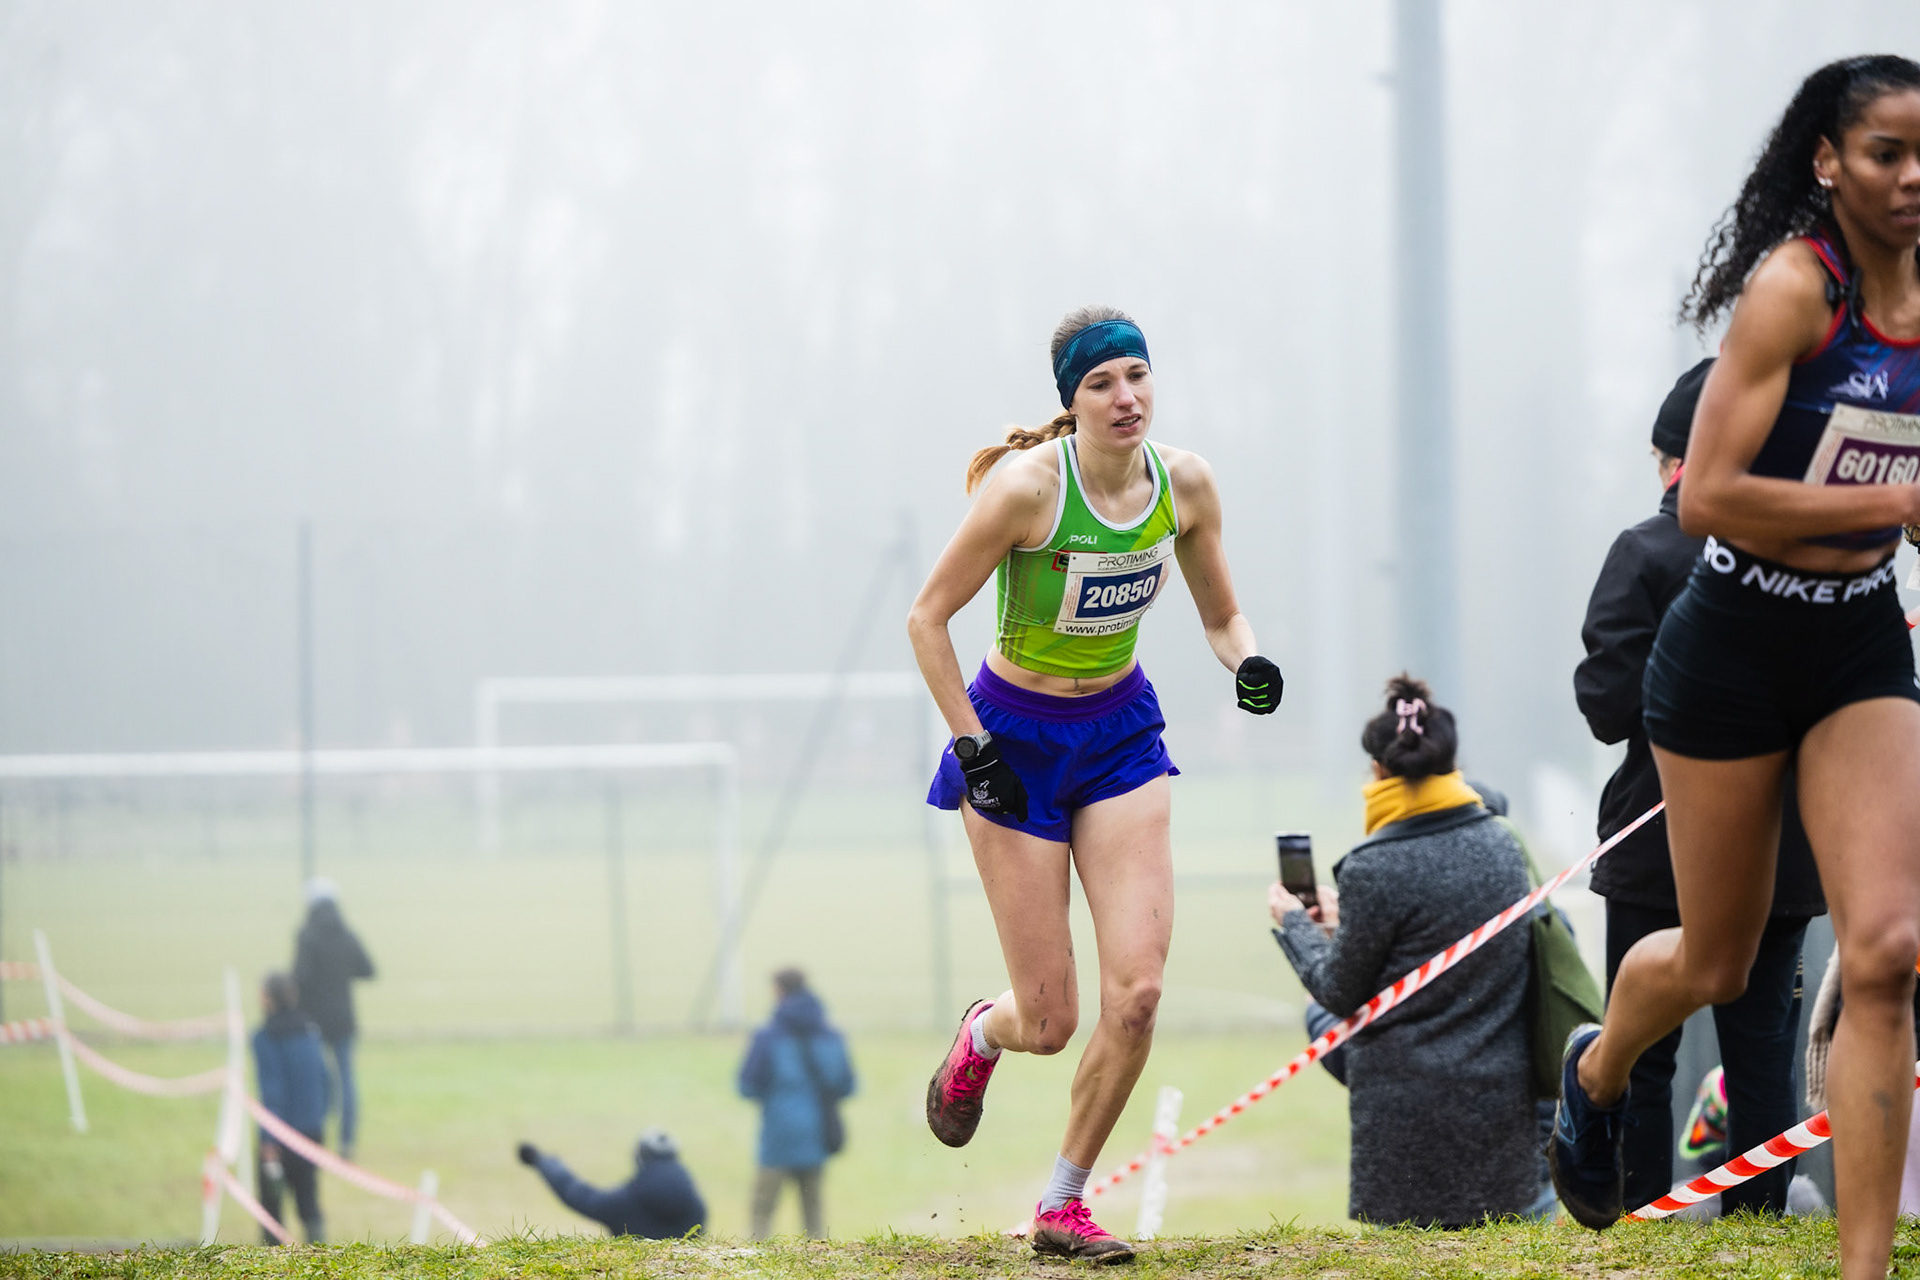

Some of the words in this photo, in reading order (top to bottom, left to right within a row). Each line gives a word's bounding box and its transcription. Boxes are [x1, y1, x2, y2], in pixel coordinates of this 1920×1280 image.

[1836, 448, 1919, 484] 60160
[1069, 535, 1098, 545] POLI
[1098, 547, 1158, 567] PROTIMING
[1083, 575, 1156, 609] 20850
[1741, 564, 1842, 604] NIKE
[1842, 557, 1895, 603] PRO
